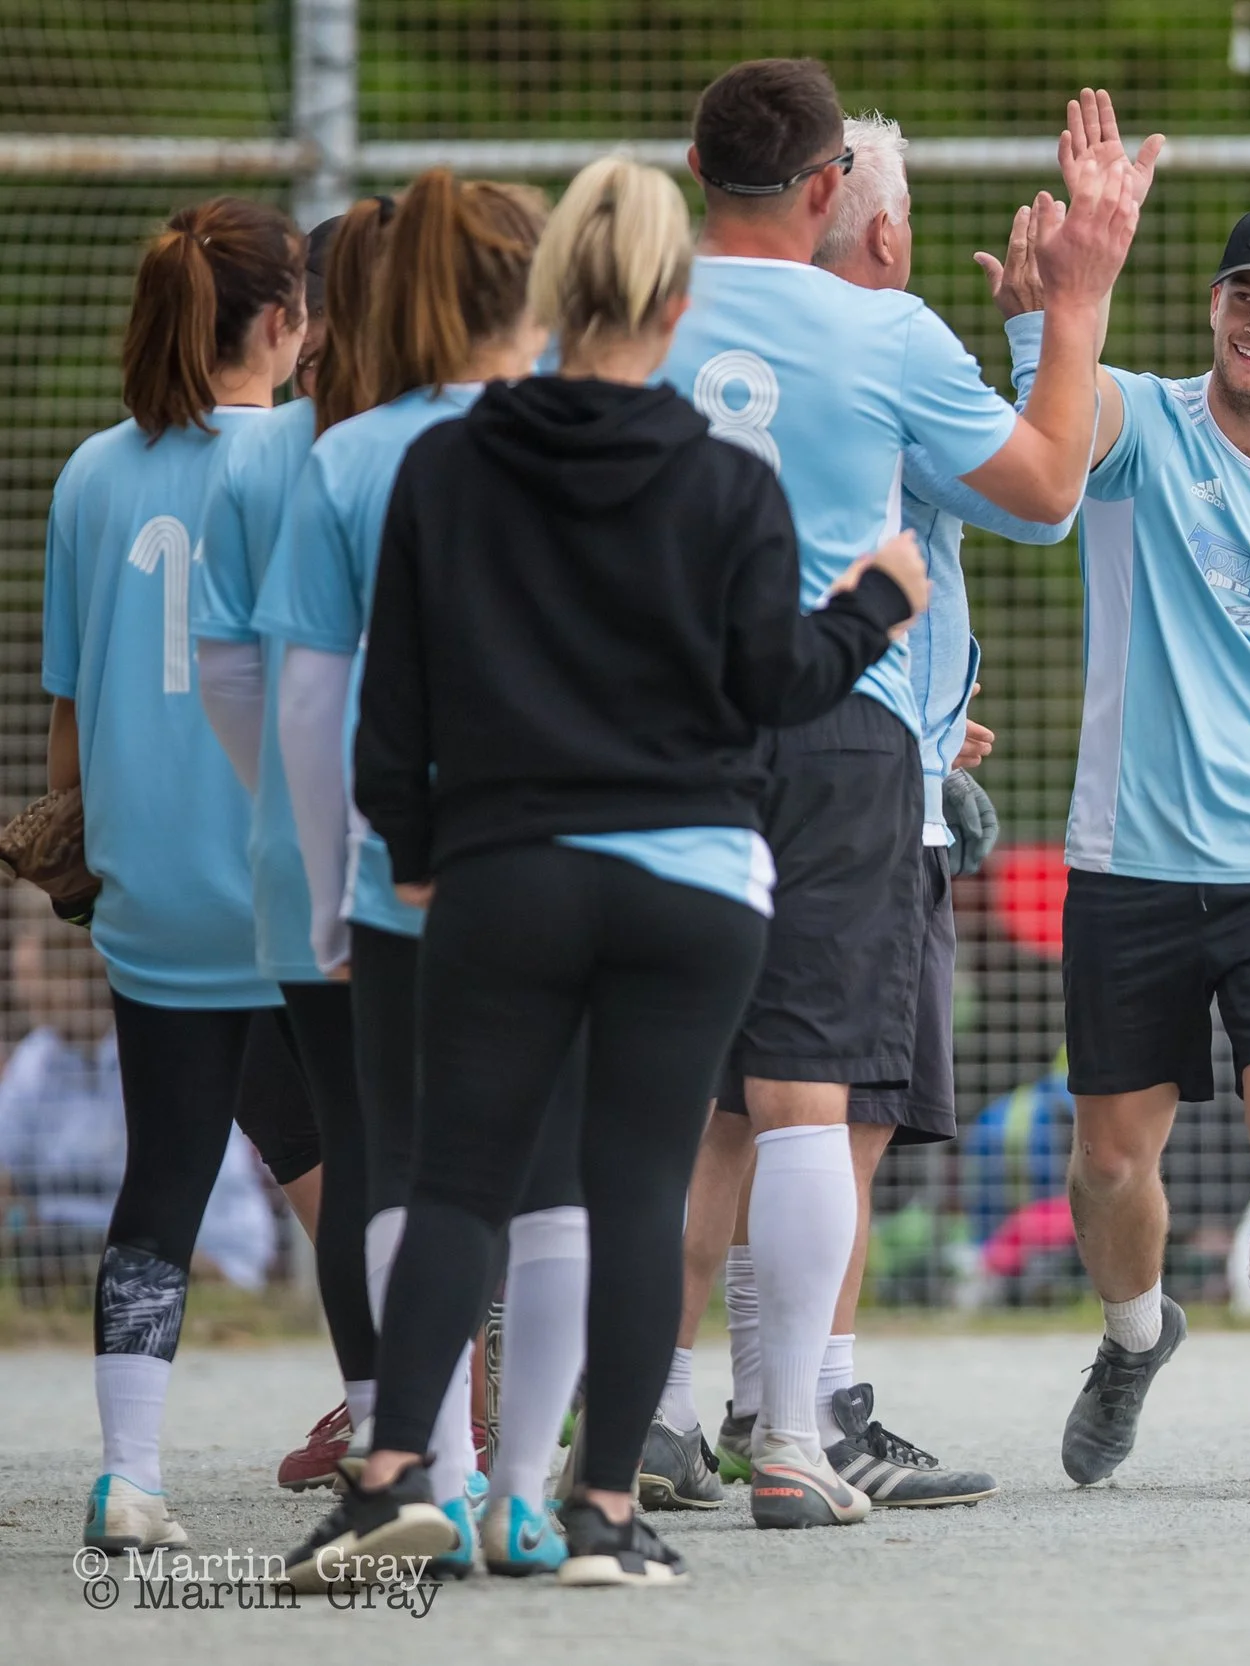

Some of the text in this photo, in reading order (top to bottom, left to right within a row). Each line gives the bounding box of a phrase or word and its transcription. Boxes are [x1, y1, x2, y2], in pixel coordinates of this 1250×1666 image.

[692, 349, 781, 479] 8
[1190, 485, 1226, 511] adidas
[128, 514, 203, 694] 1
